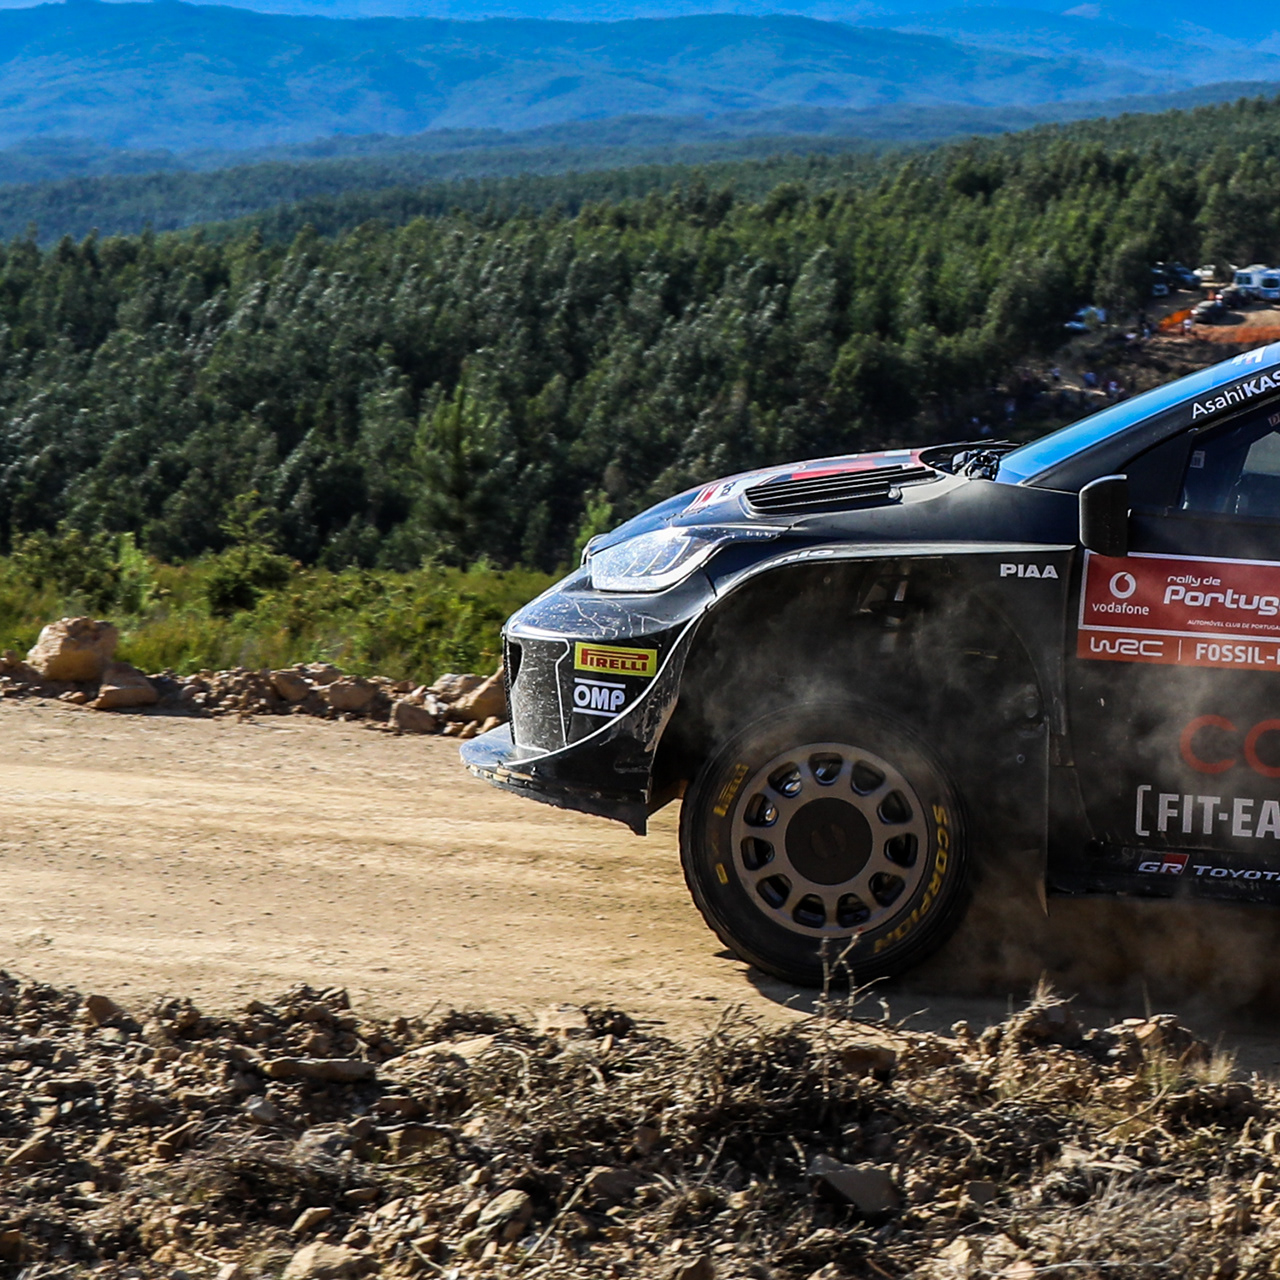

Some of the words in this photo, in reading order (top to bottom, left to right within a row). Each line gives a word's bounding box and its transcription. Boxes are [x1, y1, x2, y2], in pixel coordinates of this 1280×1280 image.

[1000, 563, 1059, 579] PIAA
[1167, 575, 1202, 587] rally
[1203, 576, 1221, 586] de
[1091, 601, 1150, 616] vodafone
[1090, 636, 1164, 657] WRC
[581, 647, 649, 671] PIRELLI
[573, 684, 625, 711] OMP
[1138, 861, 1184, 874] GR
